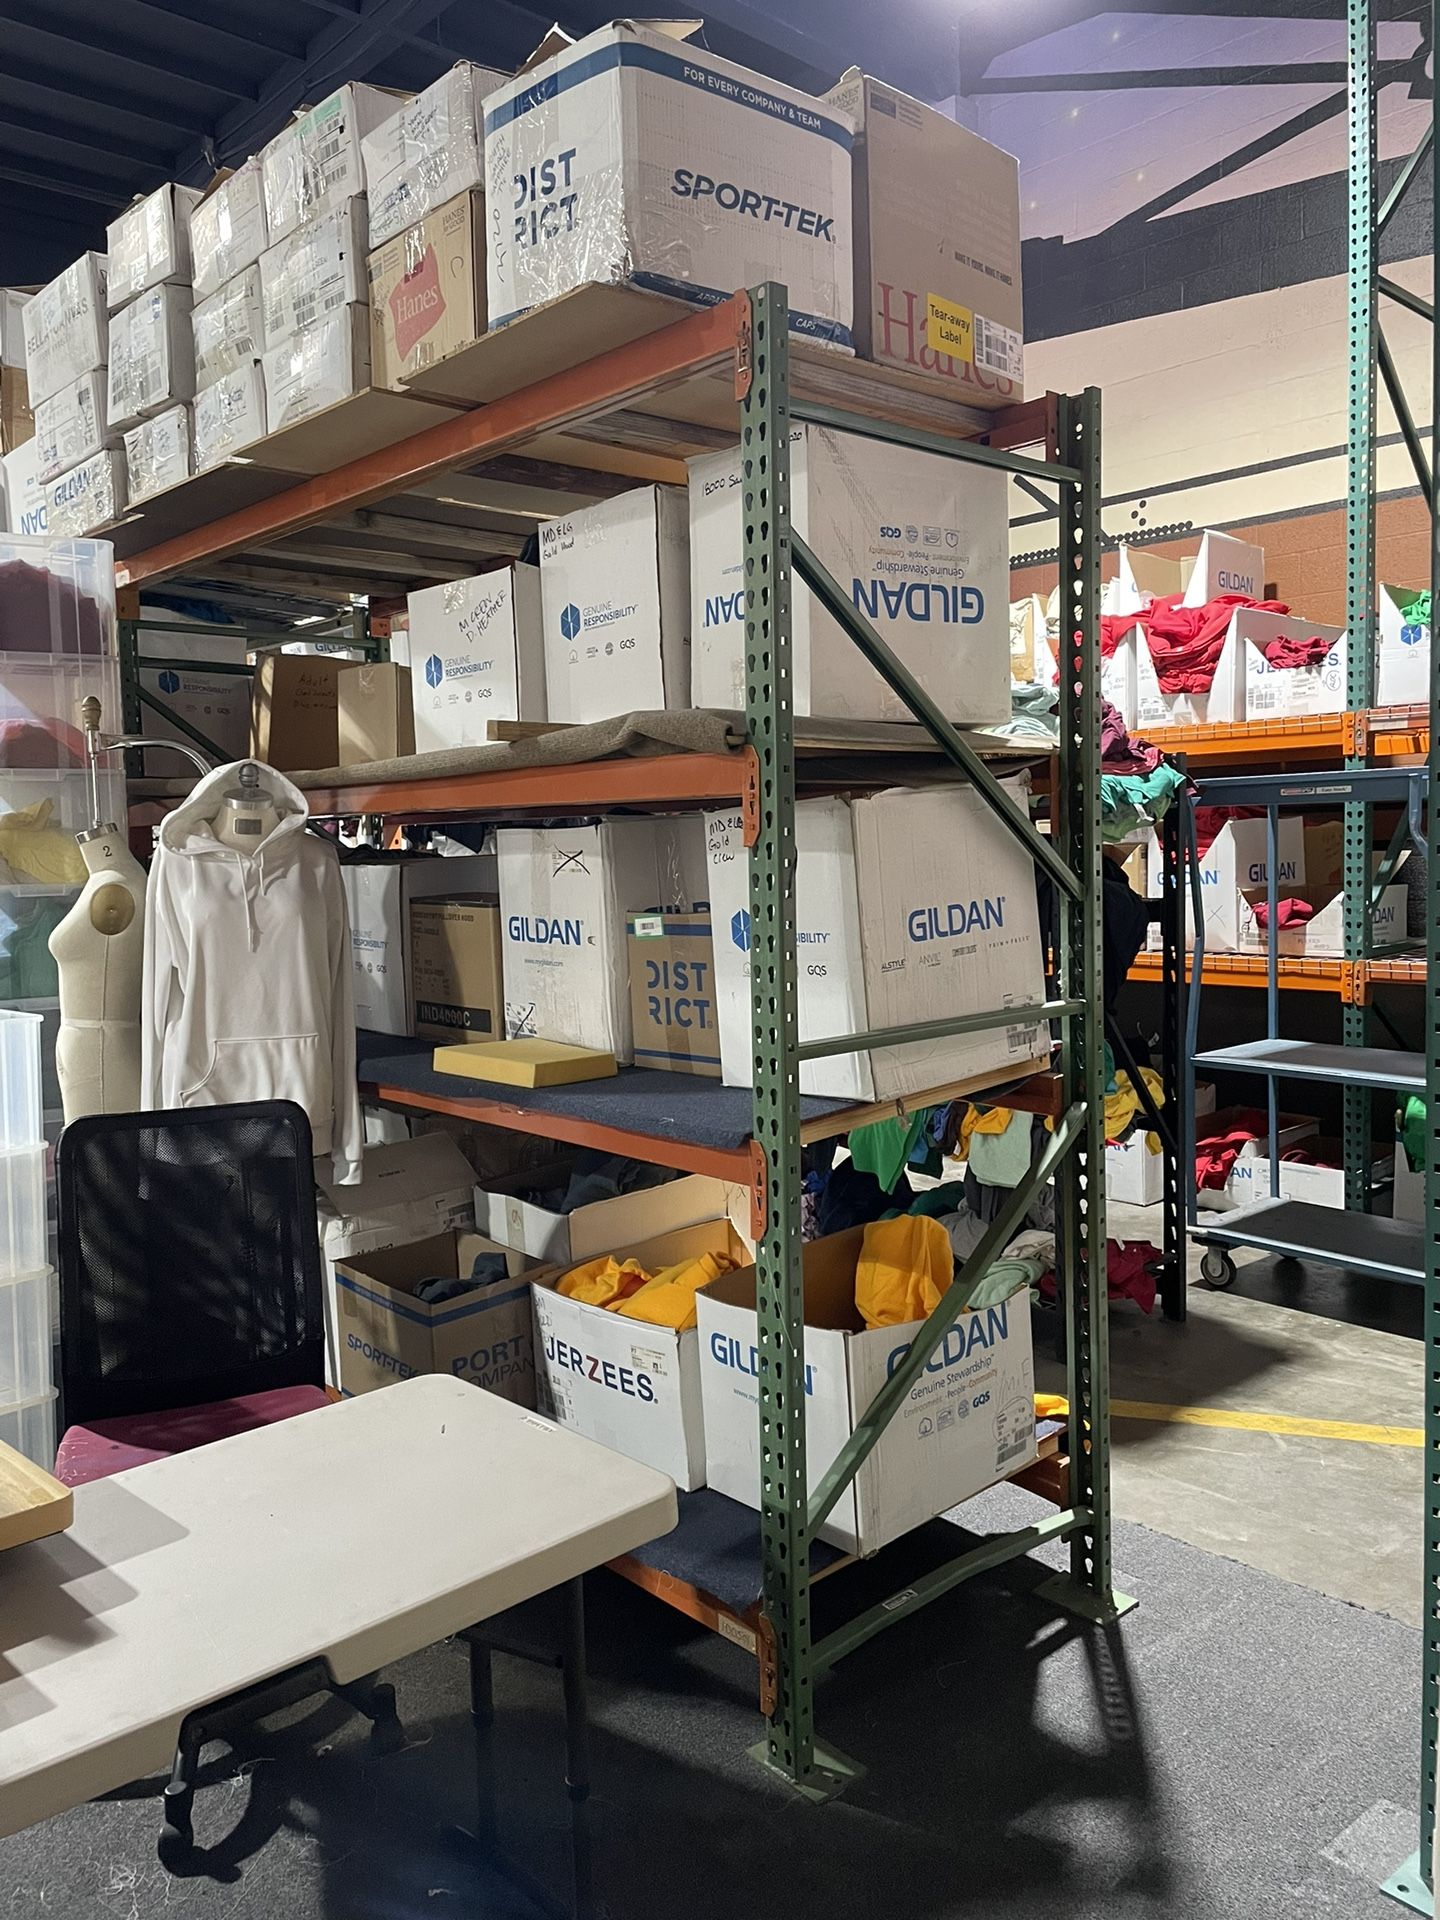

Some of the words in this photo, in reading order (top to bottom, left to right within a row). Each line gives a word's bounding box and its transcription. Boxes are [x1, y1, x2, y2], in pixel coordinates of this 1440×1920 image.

[683, 66, 705, 84] FOR
[708, 75, 739, 97] EVERY
[742, 86, 787, 117] COMPANY
[788, 106, 795, 119] &
[796, 108, 822, 130] TEAM
[514, 148, 576, 210] DIST
[671, 168, 835, 243] SPORT-TEK
[515, 192, 578, 250] RICT
[396, 285, 439, 325] Hanes
[796, 318, 817, 330] CAPS
[930, 303, 970, 333] Tear-away
[939, 326, 962, 346] Label
[54, 467, 92, 507] GILDAN
[880, 526, 901, 539] GQS
[876, 560, 929, 577] Stewardship
[930, 566, 965, 580] Genuine
[1218, 571, 1254, 594] GILDAN
[583, 601, 612, 617] GENUINE
[852, 578, 984, 624] GILDAN
[583, 605, 636, 627] RESPONSIBILITY
[620, 638, 636, 649] GQS
[445, 655, 471, 668] GENUINE
[446, 660, 493, 677] RESPONSIBILITY
[478, 688, 492, 699] GQS
[103, 845, 112, 857] 2
[508, 916, 582, 946] GILDAN
[908, 897, 1004, 943] GILDAN
[807, 965, 827, 977] GQS
[881, 958, 905, 970] ALSTYLE
[646, 960, 707, 992] DIST
[648, 996, 710, 1029] RICT
[452, 1335, 524, 1377] PORT
[910, 1379, 945, 1400] Genuine
[946, 1357, 992, 1385] Stewardship
[972, 1391, 990, 1408] GQS
